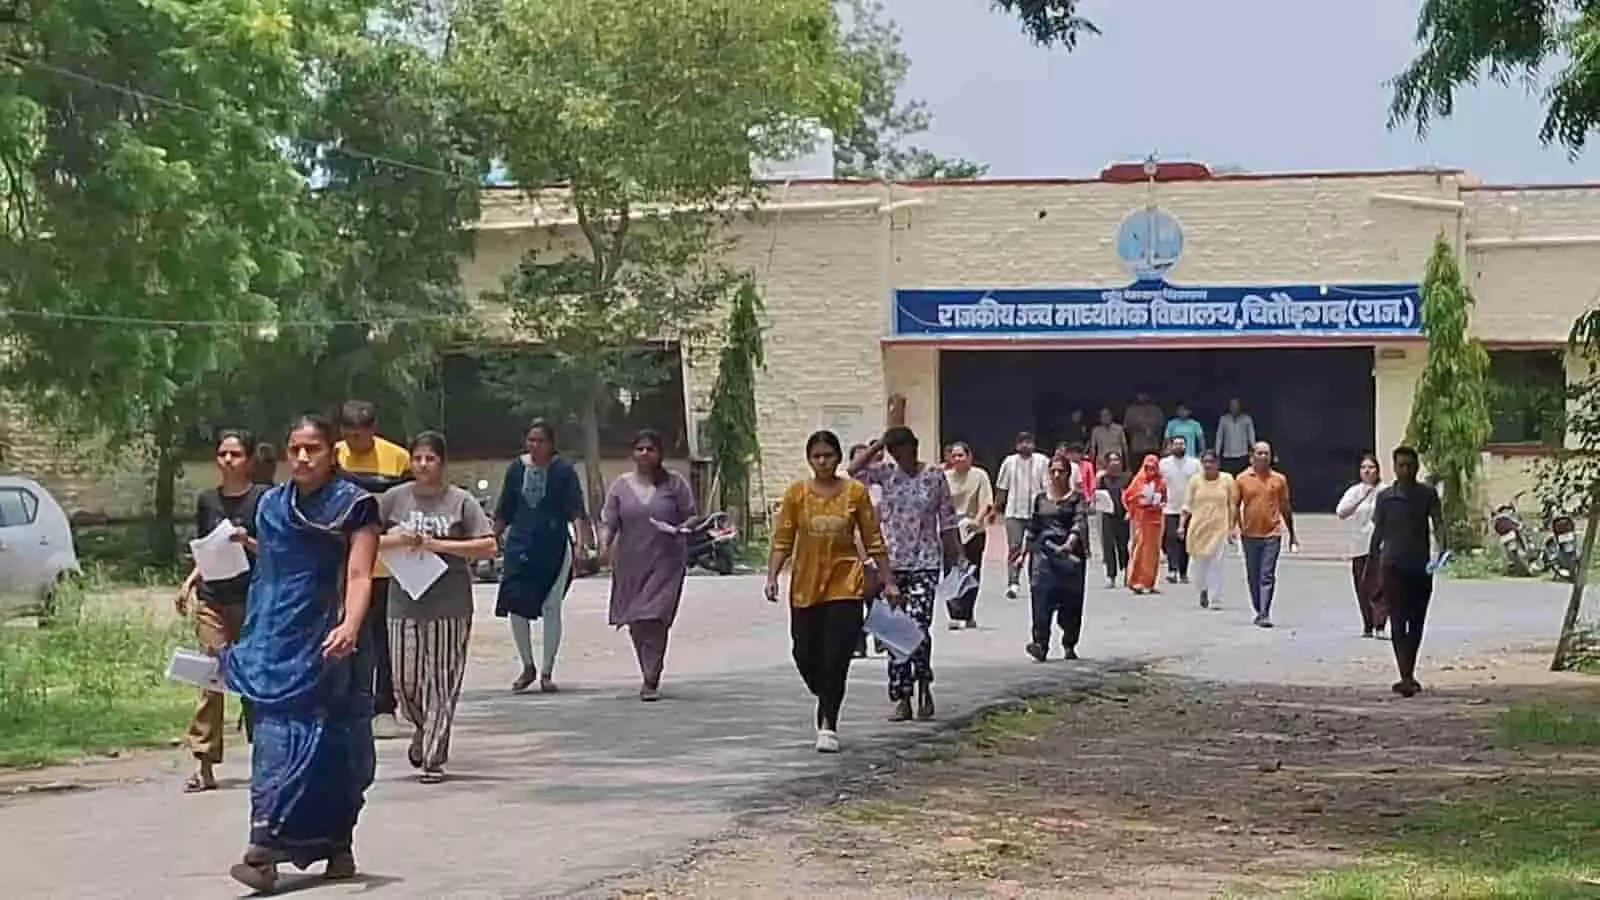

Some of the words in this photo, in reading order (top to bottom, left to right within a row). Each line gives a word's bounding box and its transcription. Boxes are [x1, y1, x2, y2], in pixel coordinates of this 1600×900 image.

[938, 298, 1015, 328] राजकीय
[1016, 304, 1052, 327] उच्च
[1055, 299, 1147, 328] माध्यमिक
